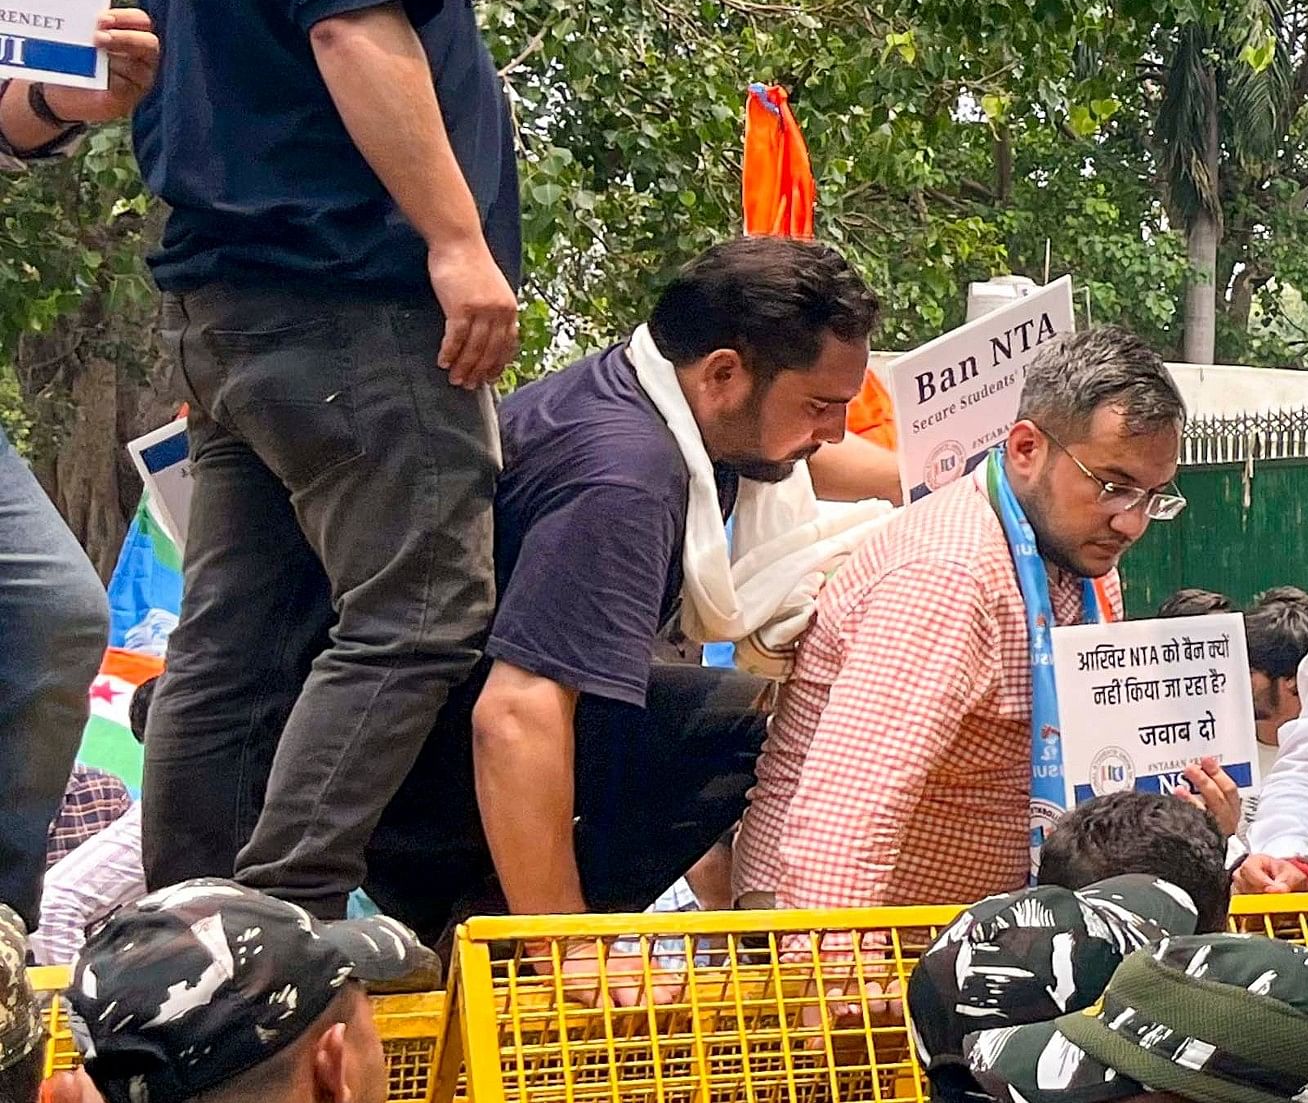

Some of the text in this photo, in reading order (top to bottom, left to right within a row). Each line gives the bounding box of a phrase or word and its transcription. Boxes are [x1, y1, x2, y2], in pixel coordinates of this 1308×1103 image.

[915, 312, 1057, 405] Ban NTA
[912, 404, 957, 434] Secure
[1077, 633, 1230, 671] आखिर NTA को बैन क्यों
[1091, 668, 1227, 705] नहीं किया जा रहा है?
[1138, 710, 1216, 746] जवाब दो
